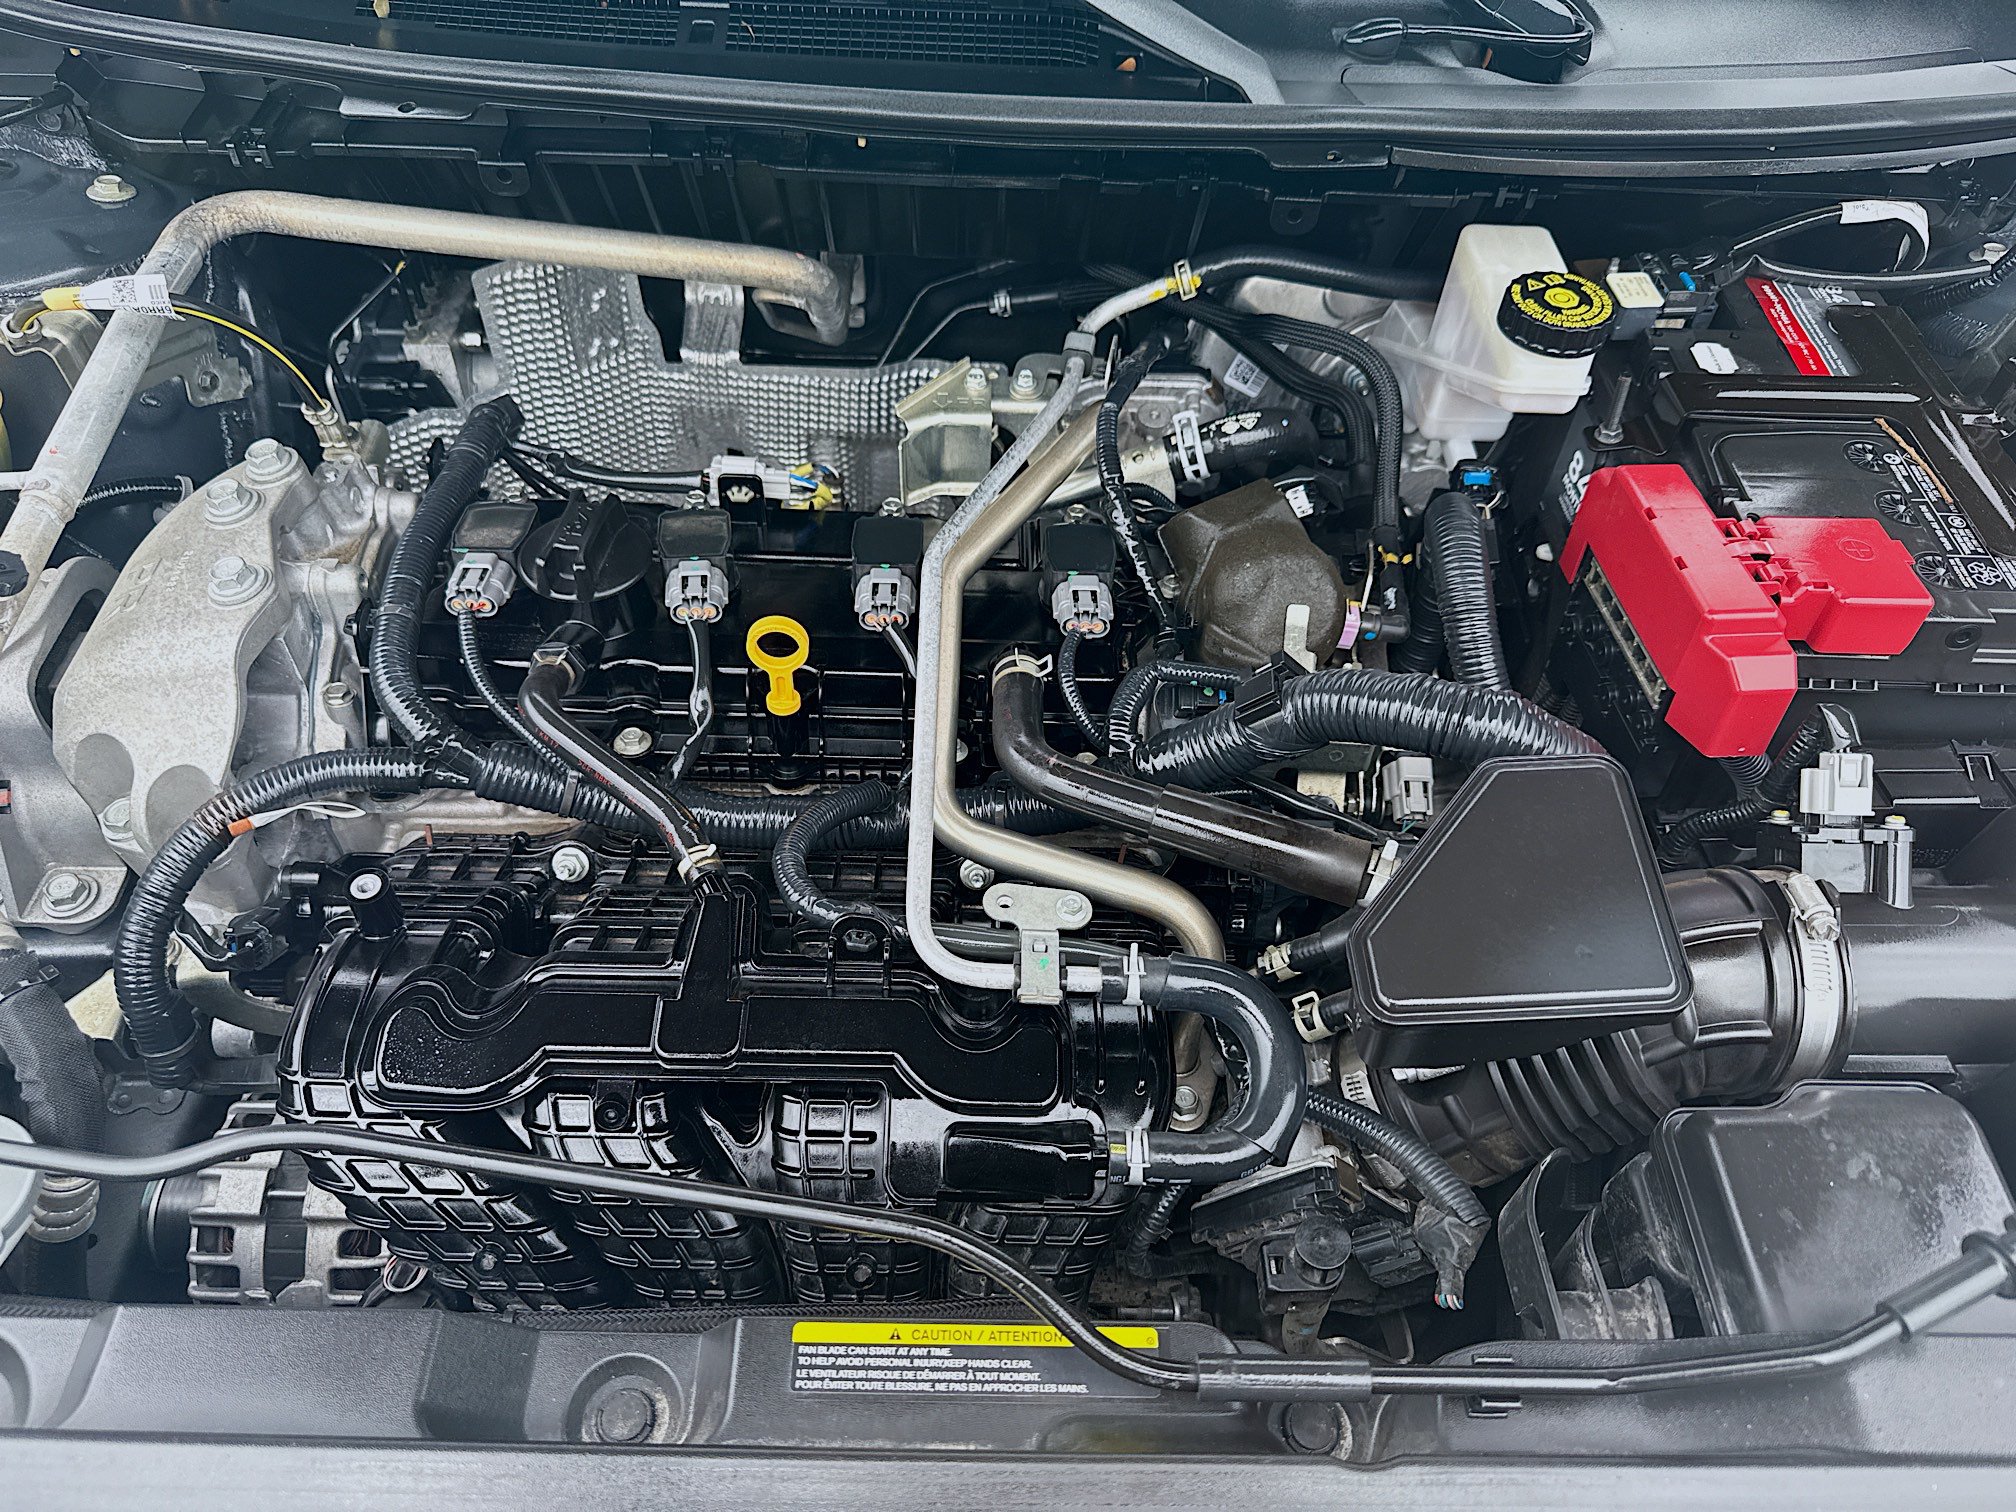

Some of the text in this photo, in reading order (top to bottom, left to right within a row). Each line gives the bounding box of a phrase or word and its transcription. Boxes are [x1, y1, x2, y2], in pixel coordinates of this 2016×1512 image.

[911, 1329, 973, 1341] CAUTION
[988, 1331, 1063, 1342] ATTENTION
[798, 1345, 953, 1356] FAN BLADE CAN START AT ANY TIME.
[797, 1356, 811, 1366] TO
[811, 1357, 836, 1366] HELP
[836, 1357, 864, 1366] AVOID
[865, 1358, 913, 1367] PERSONAL
[968, 1359, 1000, 1368] HANDS
[1001, 1360, 1033, 1369] CLEAR.
[796, 1369, 808, 1378] LE
[808, 1369, 867, 1378] VENTILATEUR
[867, 1370, 902, 1379] RISQUE
[903, 1371, 915, 1379] DE
[917, 1369, 966, 1380] DÉMARRER
[975, 1372, 1000, 1381] TOUT
[1000, 1372, 1041, 1381] MOMENT.
[795, 1378, 1089, 1393] POUR ÉVITER TOUTE BLESSURE, NE PAS EN APPROCHER LES MAINS.
